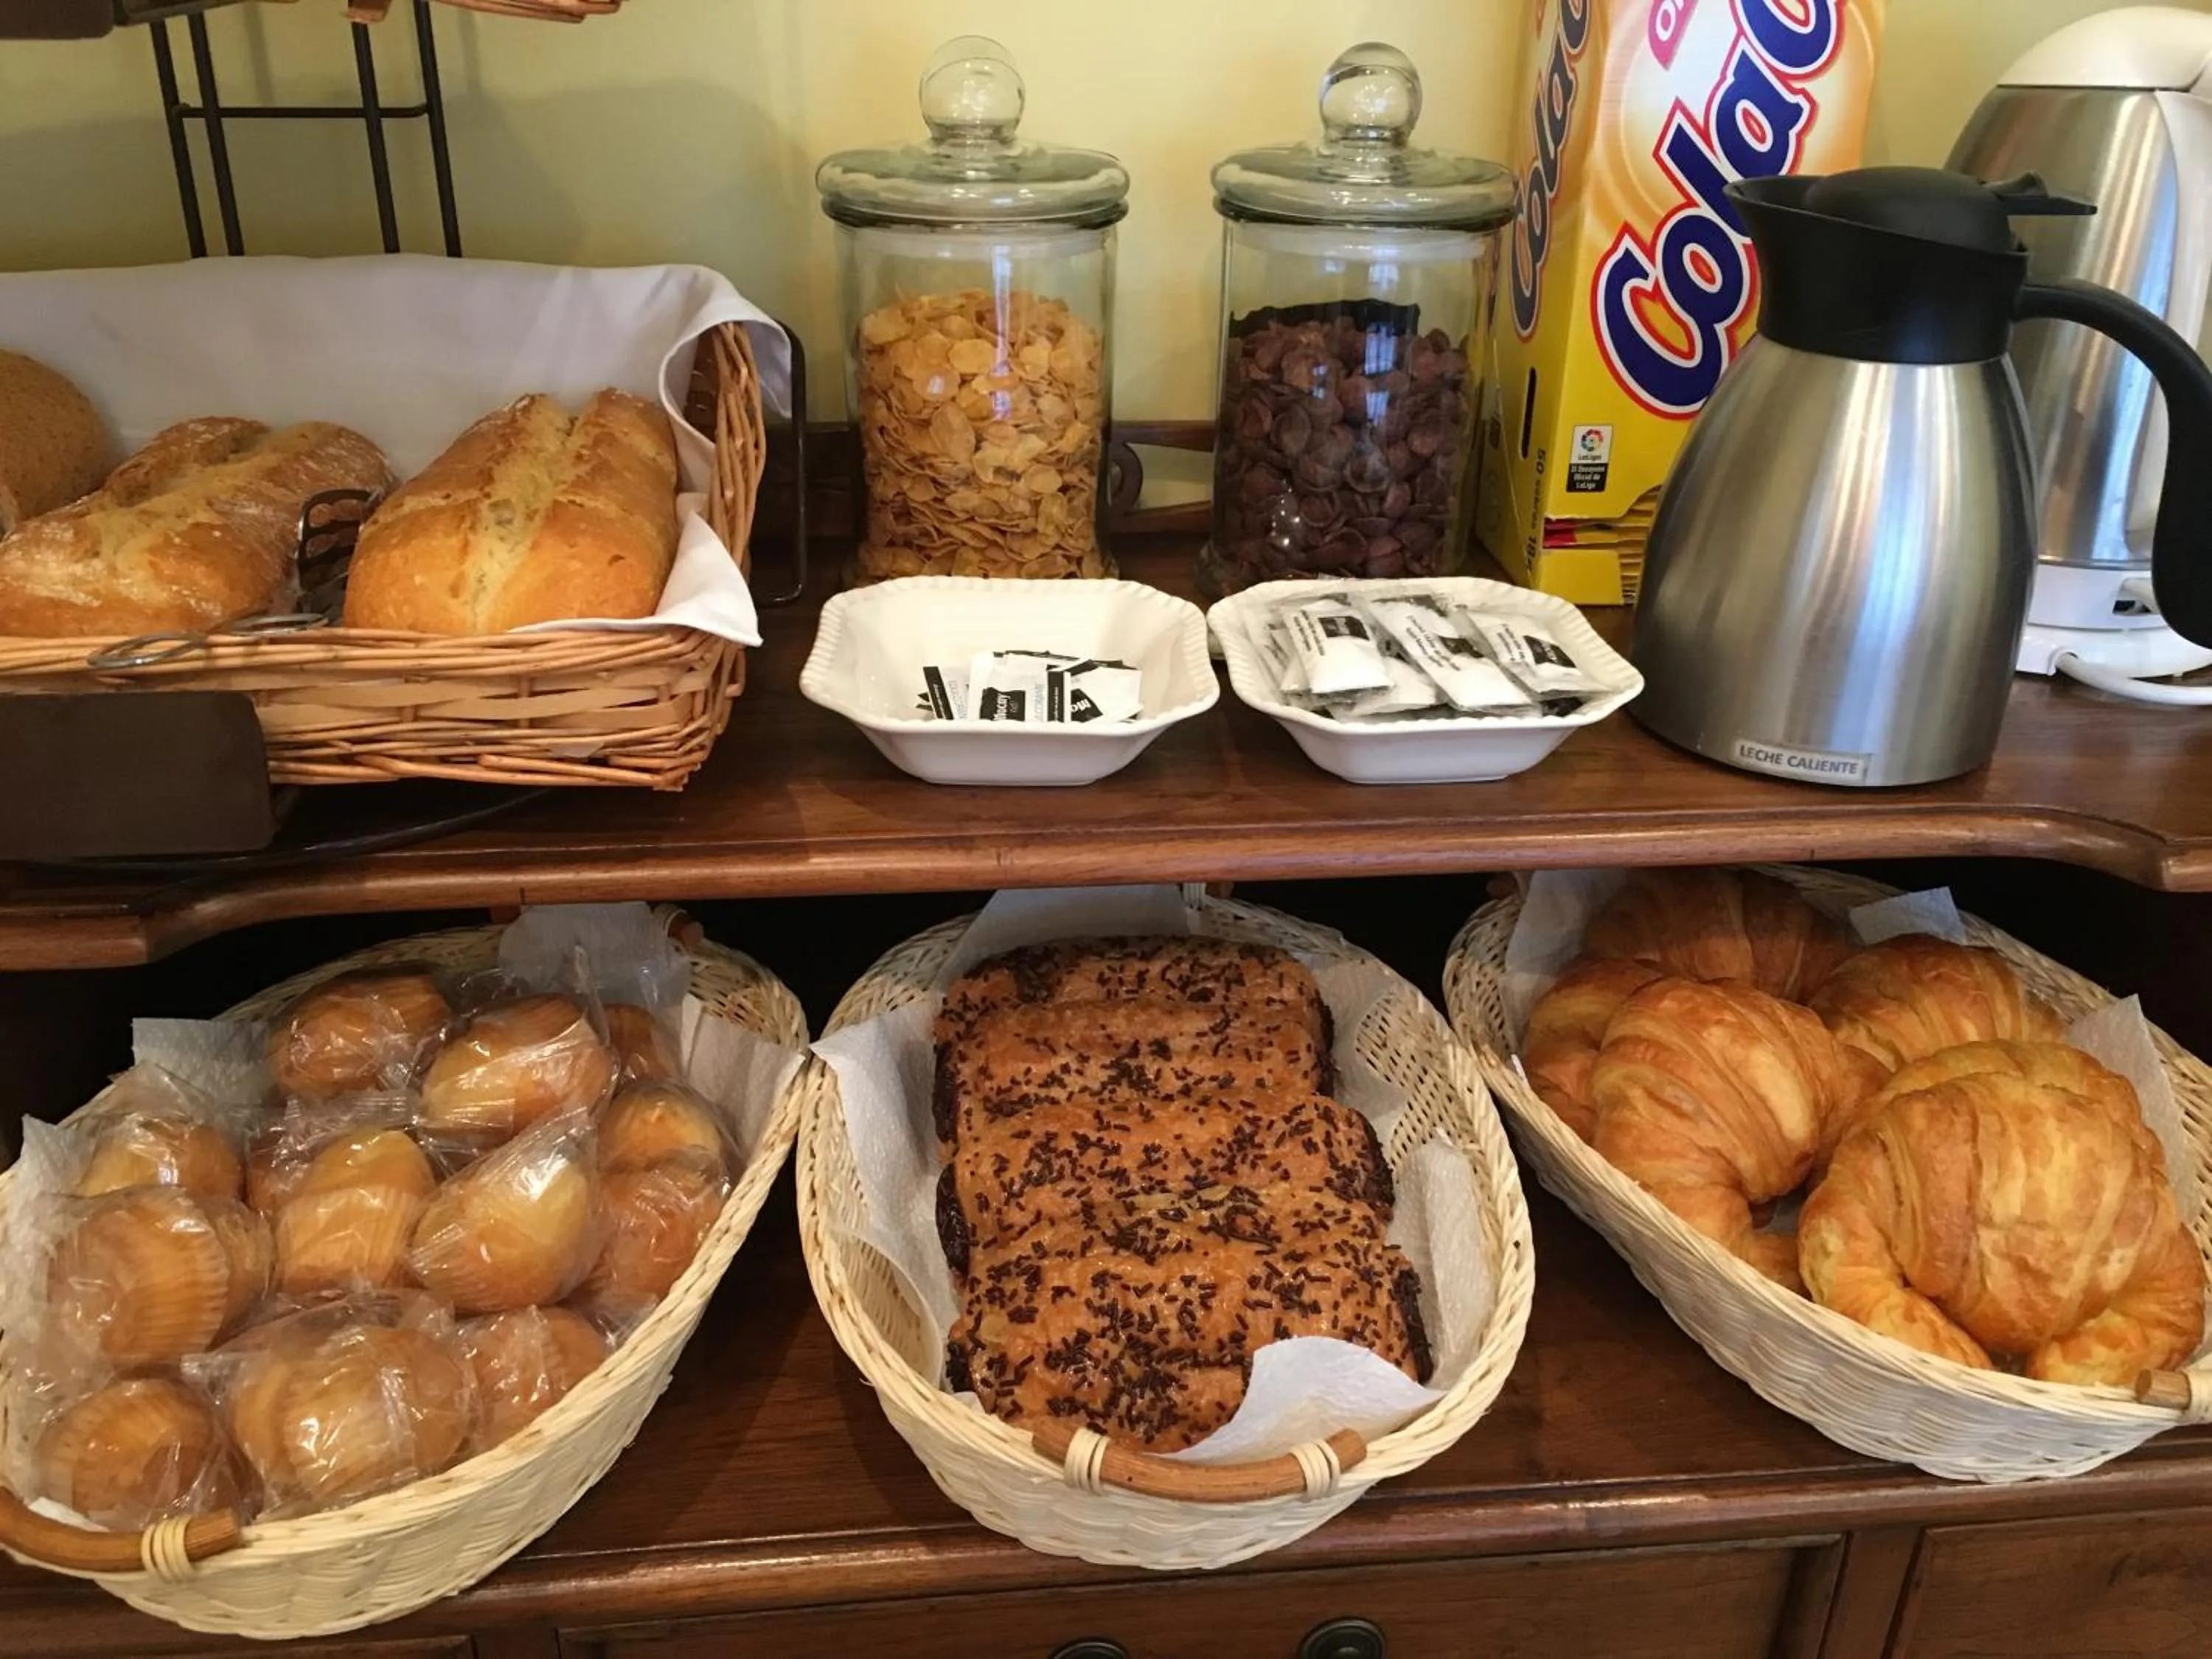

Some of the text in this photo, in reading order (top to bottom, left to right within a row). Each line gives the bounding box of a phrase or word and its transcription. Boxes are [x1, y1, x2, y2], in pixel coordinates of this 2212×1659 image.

[1535, 448, 1546, 474] 50
[1739, 744, 1860, 775] LECHE CALIENTE
